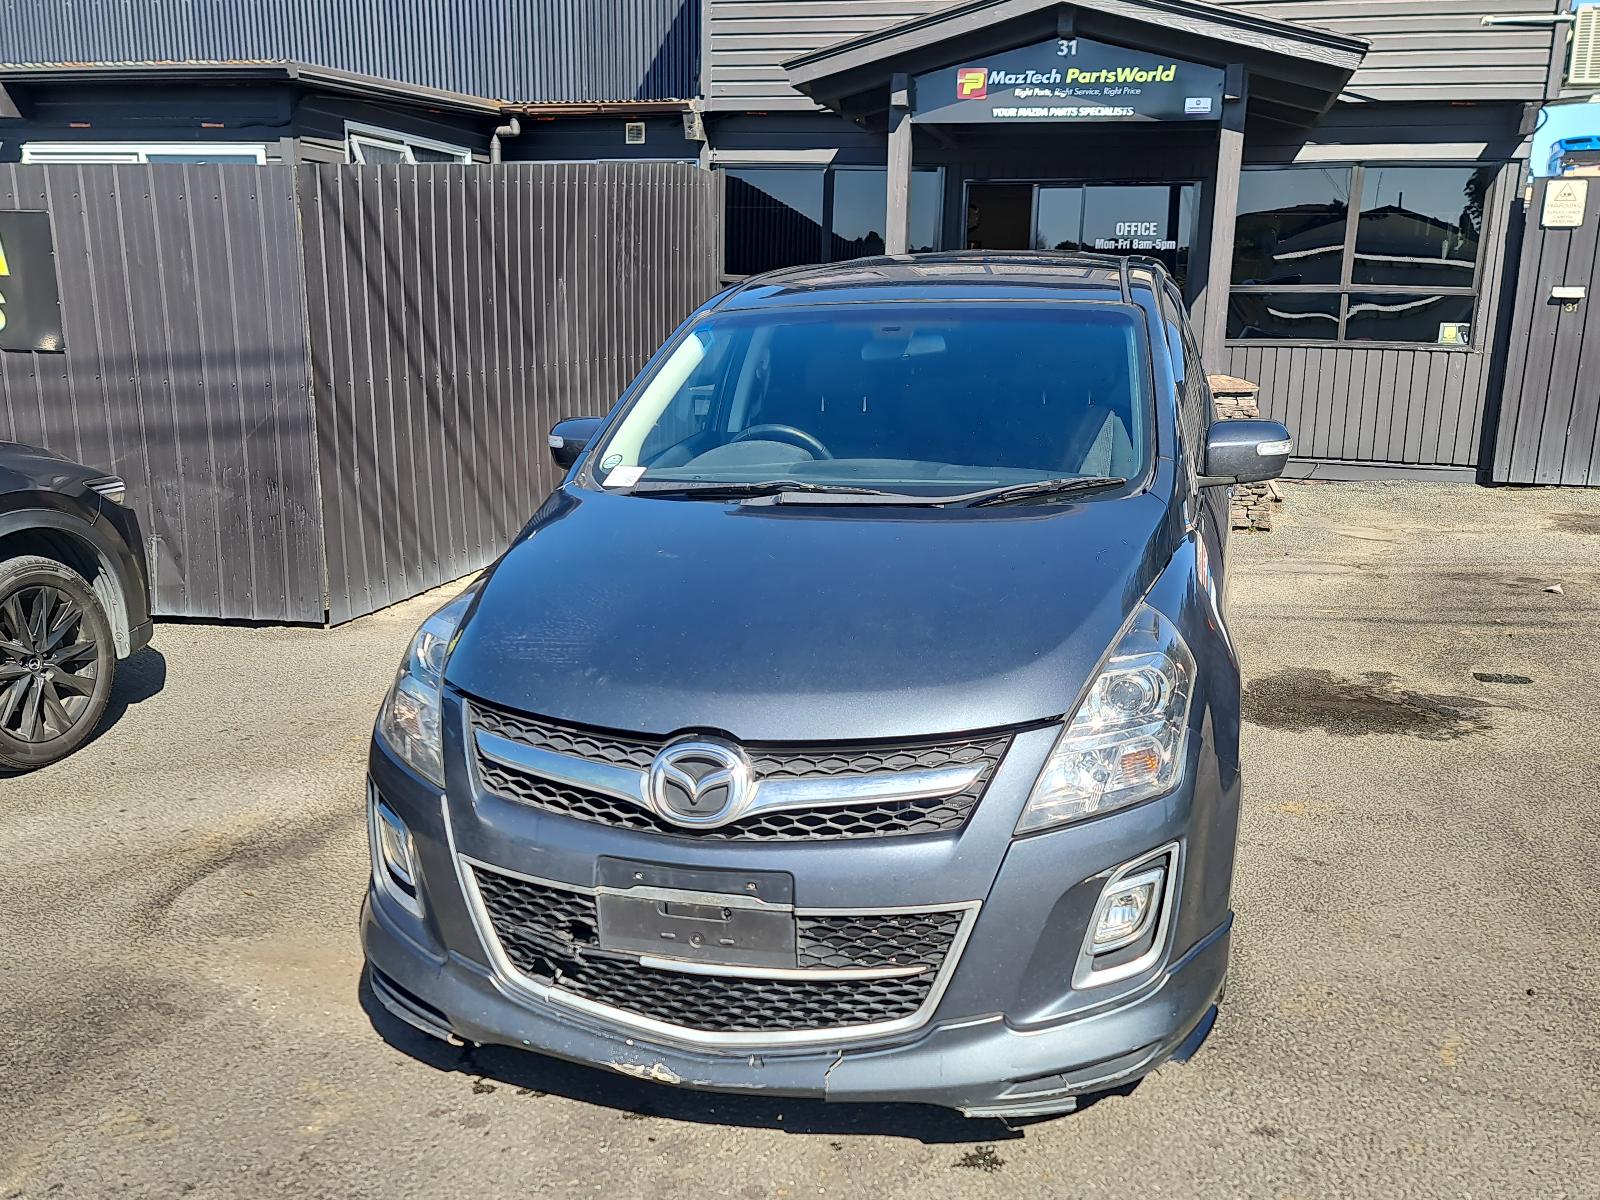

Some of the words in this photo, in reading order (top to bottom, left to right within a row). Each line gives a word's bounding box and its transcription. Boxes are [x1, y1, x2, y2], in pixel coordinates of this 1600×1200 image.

[1057, 40, 1077, 56] 31
[988, 69, 1062, 84] MazTech
[1066, 65, 1176, 83] PartsWorld
[1014, 88, 1033, 98] Right
[1033, 87, 1053, 97] Parts,
[1054, 87, 1073, 98] Right
[1074, 87, 1101, 97] Service,
[1103, 87, 1122, 97] Right
[1123, 86, 1141, 95] Price
[992, 107, 1018, 117] YOUR
[1018, 107, 1048, 117] MAZDA
[1049, 107, 1078, 117] PARTS
[1078, 106, 1135, 117] SPECIALISTS
[1115, 222, 1158, 236] OFFICE
[1095, 238, 1130, 250] Mon-Fri
[1132, 239, 1176, 251] 8am-5pm
[1565, 303, 1578, 312] 31
